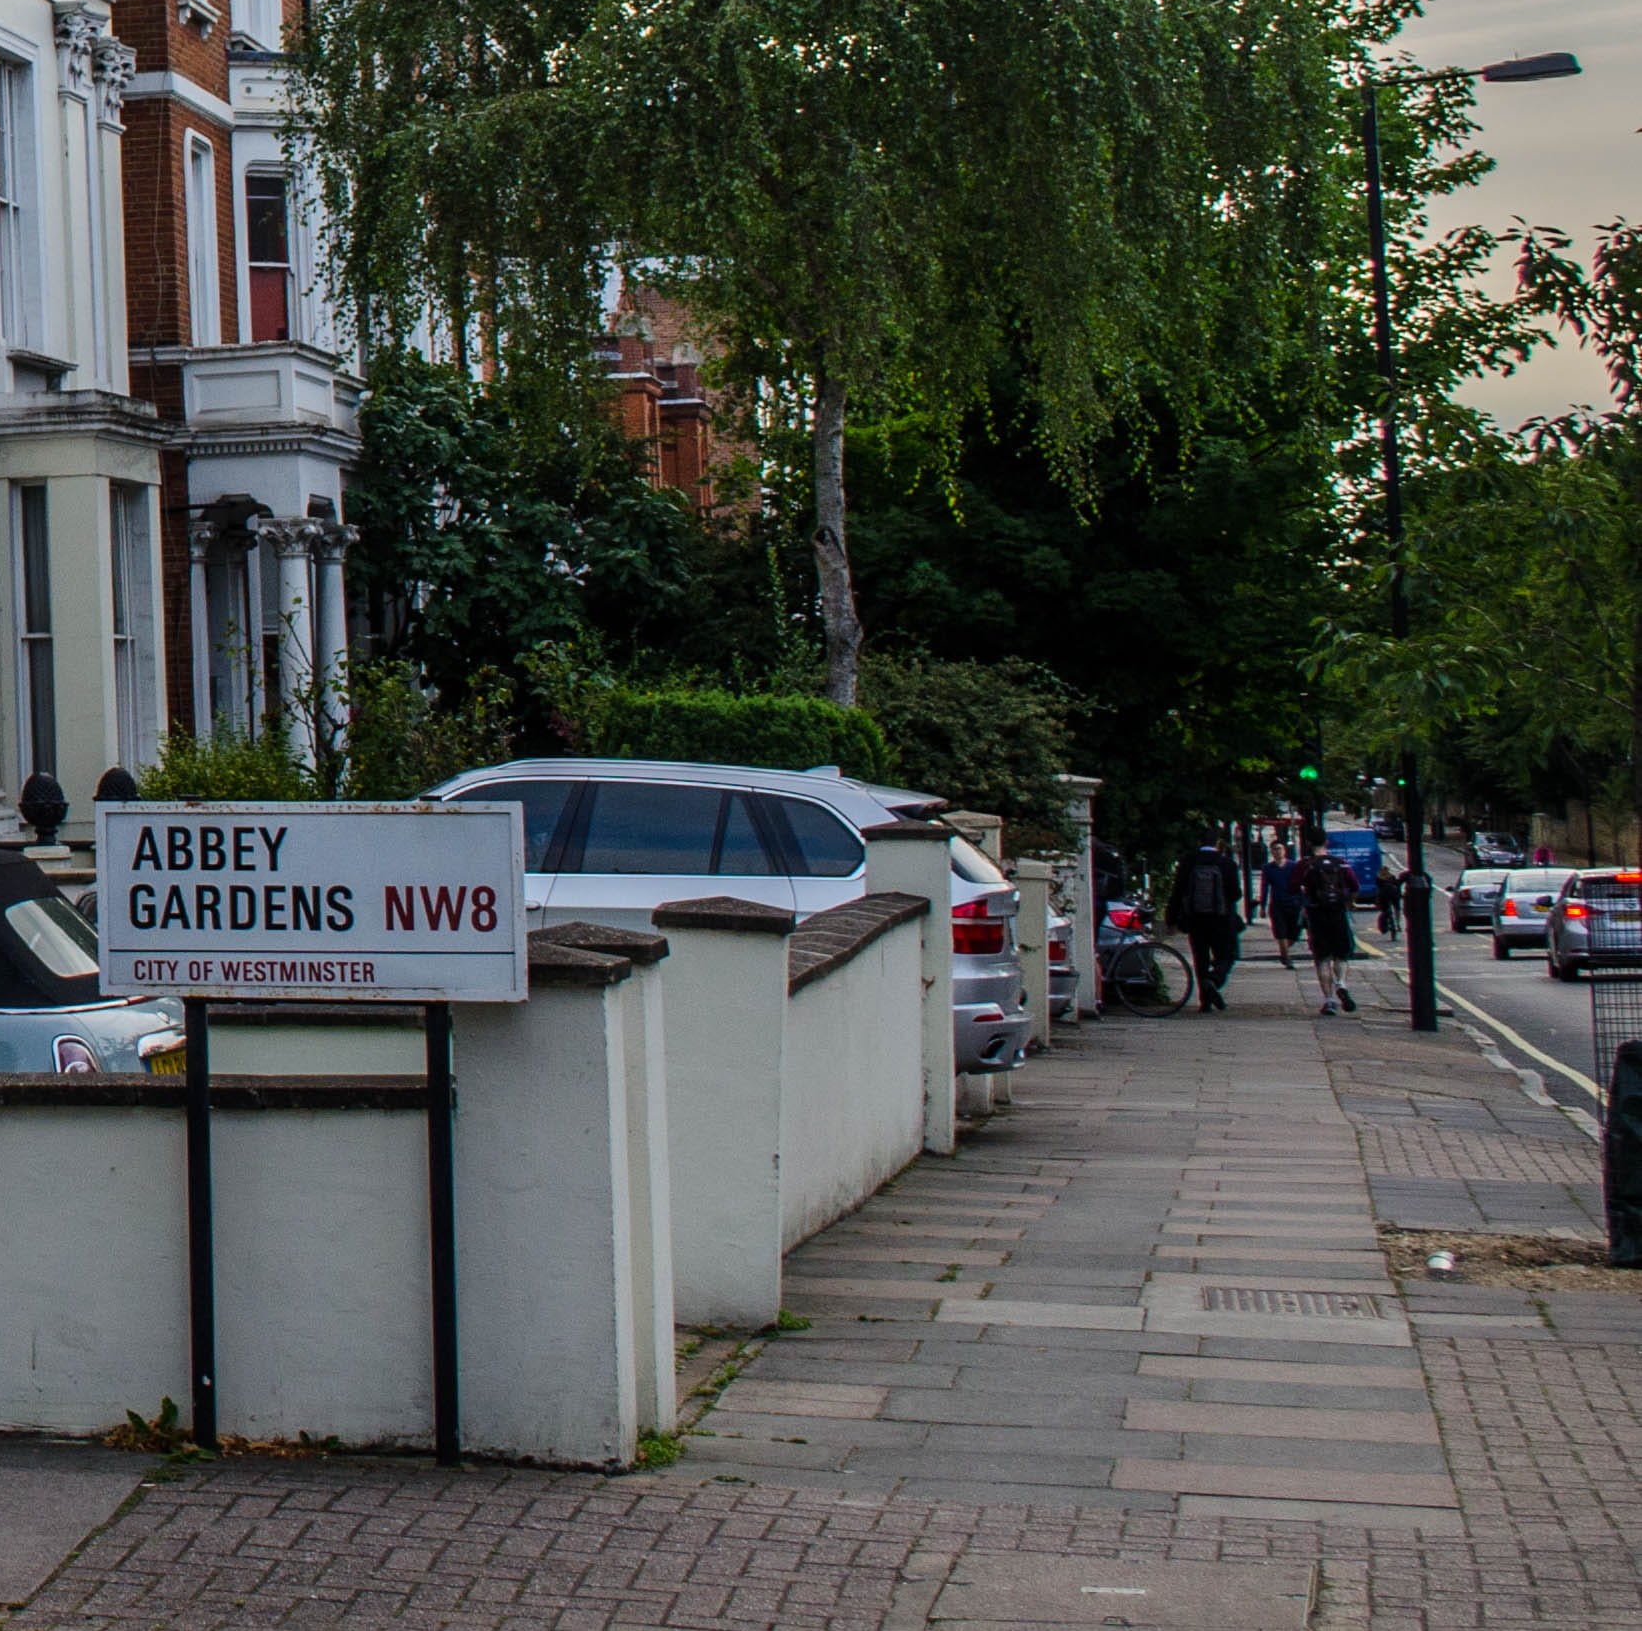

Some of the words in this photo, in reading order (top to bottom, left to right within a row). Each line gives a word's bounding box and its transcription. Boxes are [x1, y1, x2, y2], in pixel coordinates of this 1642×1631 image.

[131, 825, 289, 871] ABBEY
[128, 883, 356, 933] GARDENS
[384, 885, 498, 933] NW8
[133, 959, 180, 982] CITY
[188, 960, 214, 982] OF
[220, 960, 376, 983] WESTMINSTER
